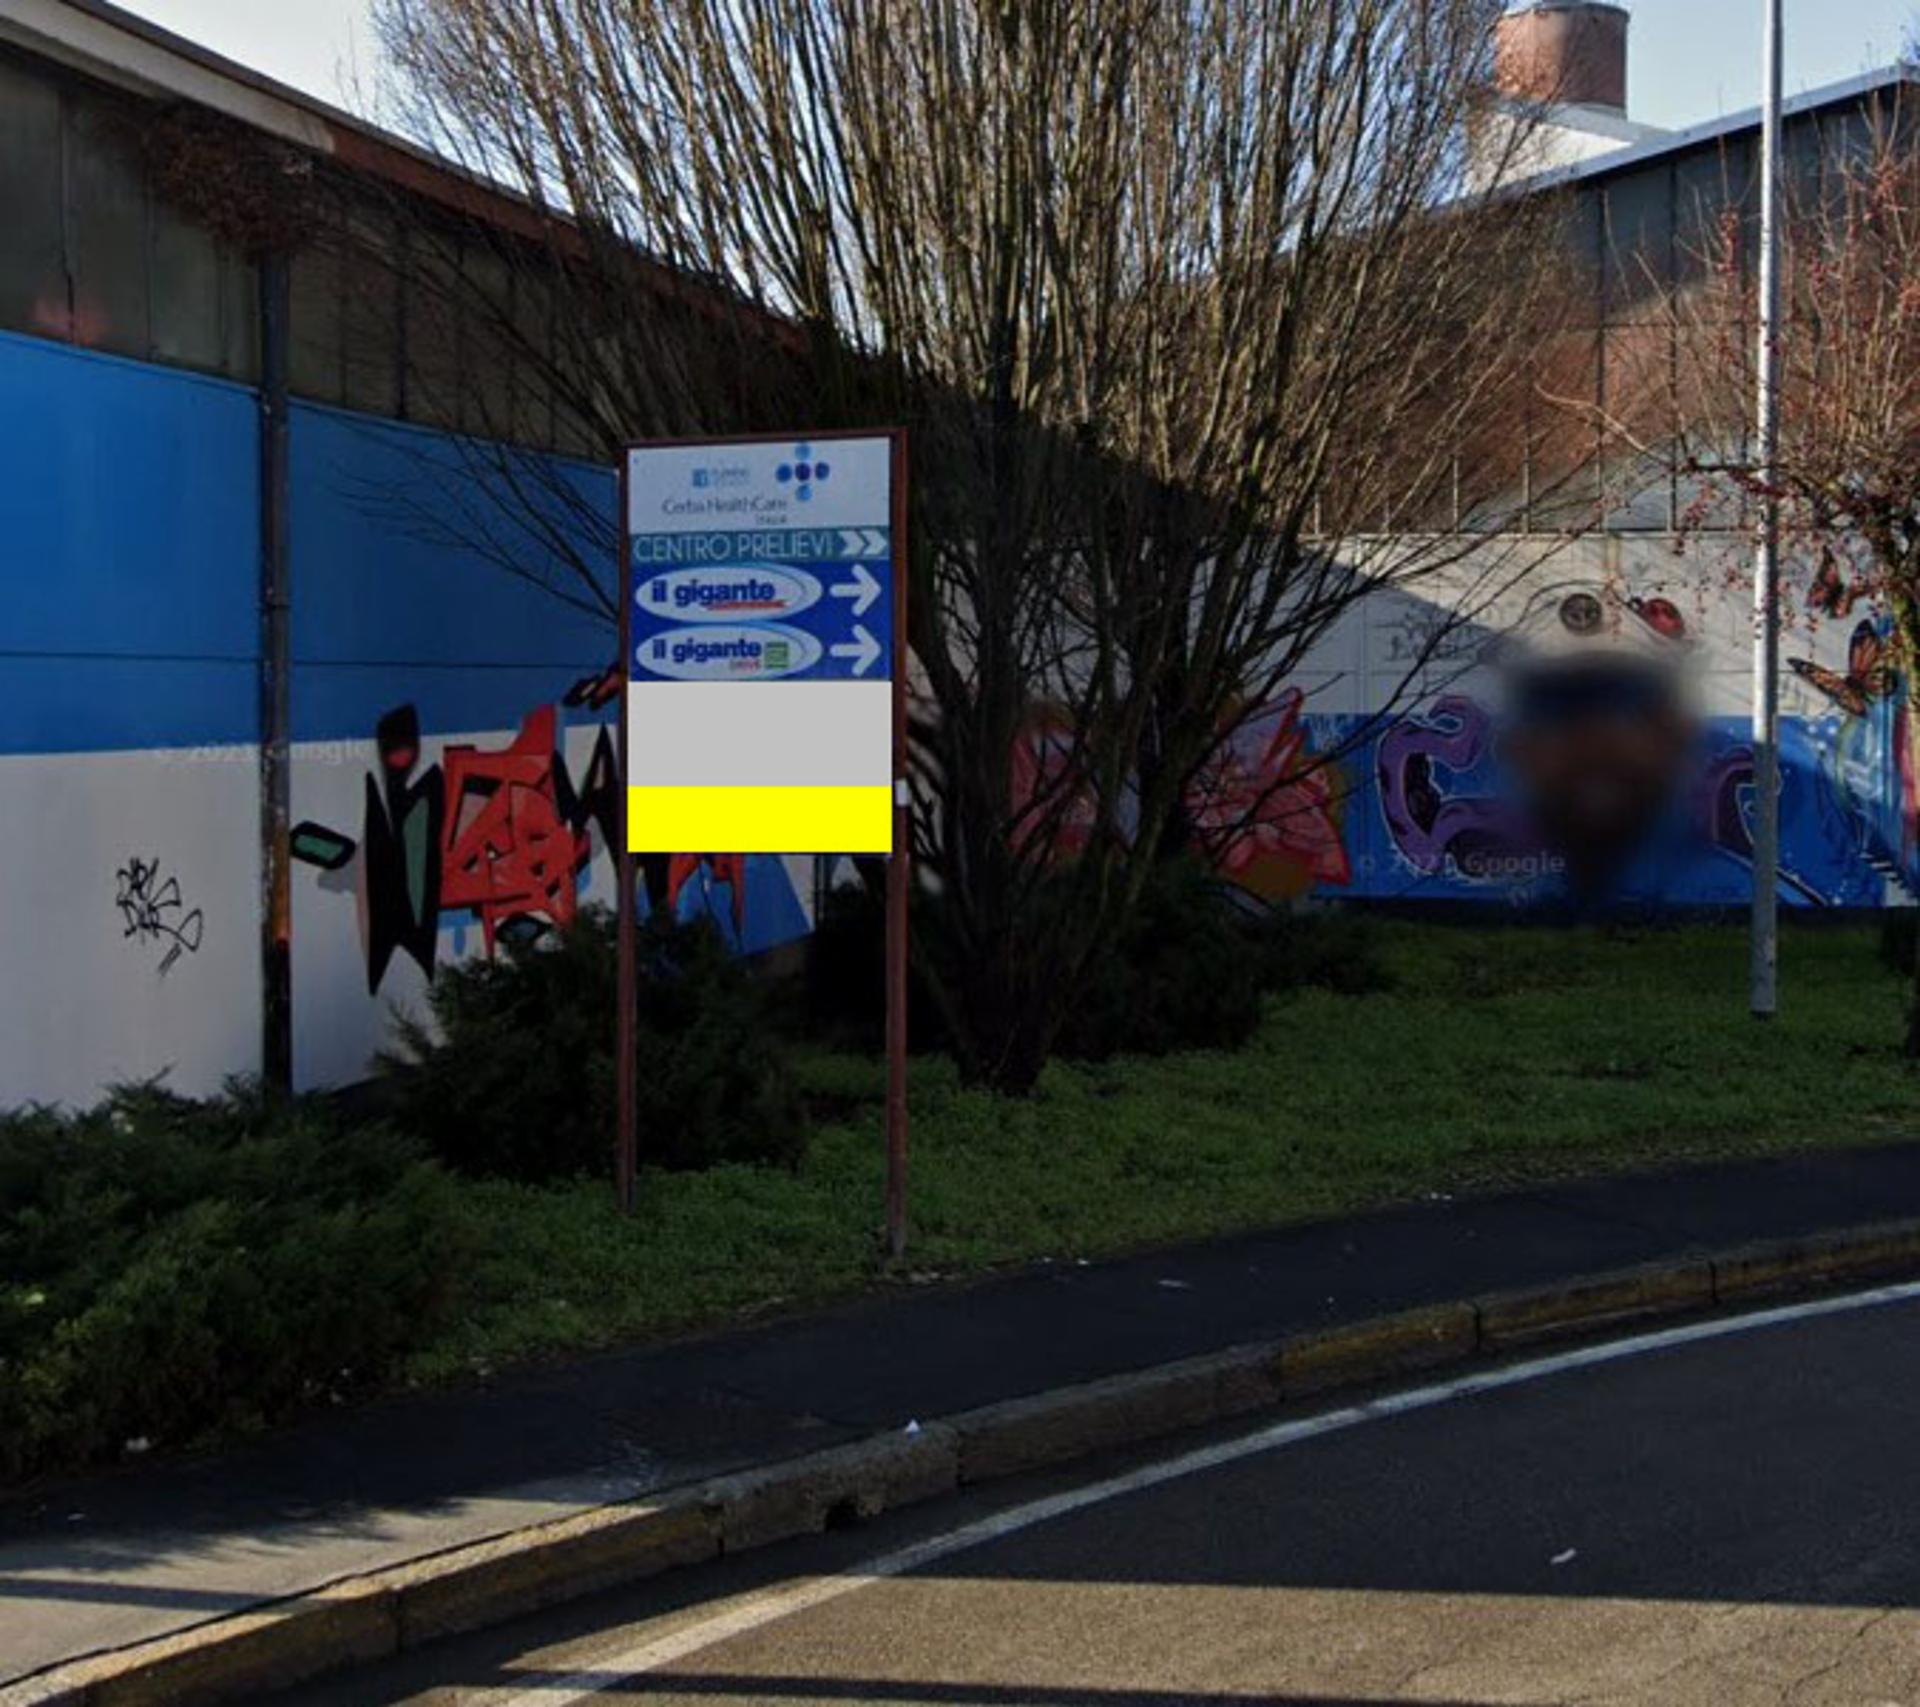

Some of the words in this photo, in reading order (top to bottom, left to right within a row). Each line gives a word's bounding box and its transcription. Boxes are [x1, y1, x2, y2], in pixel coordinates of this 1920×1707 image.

[634, 533, 731, 562] CENTRO
[737, 530, 833, 558] PRELIEVI
[651, 578, 668, 603] il
[673, 578, 776, 608] gigante
[652, 638, 667, 659] il
[671, 638, 762, 663] gigante
